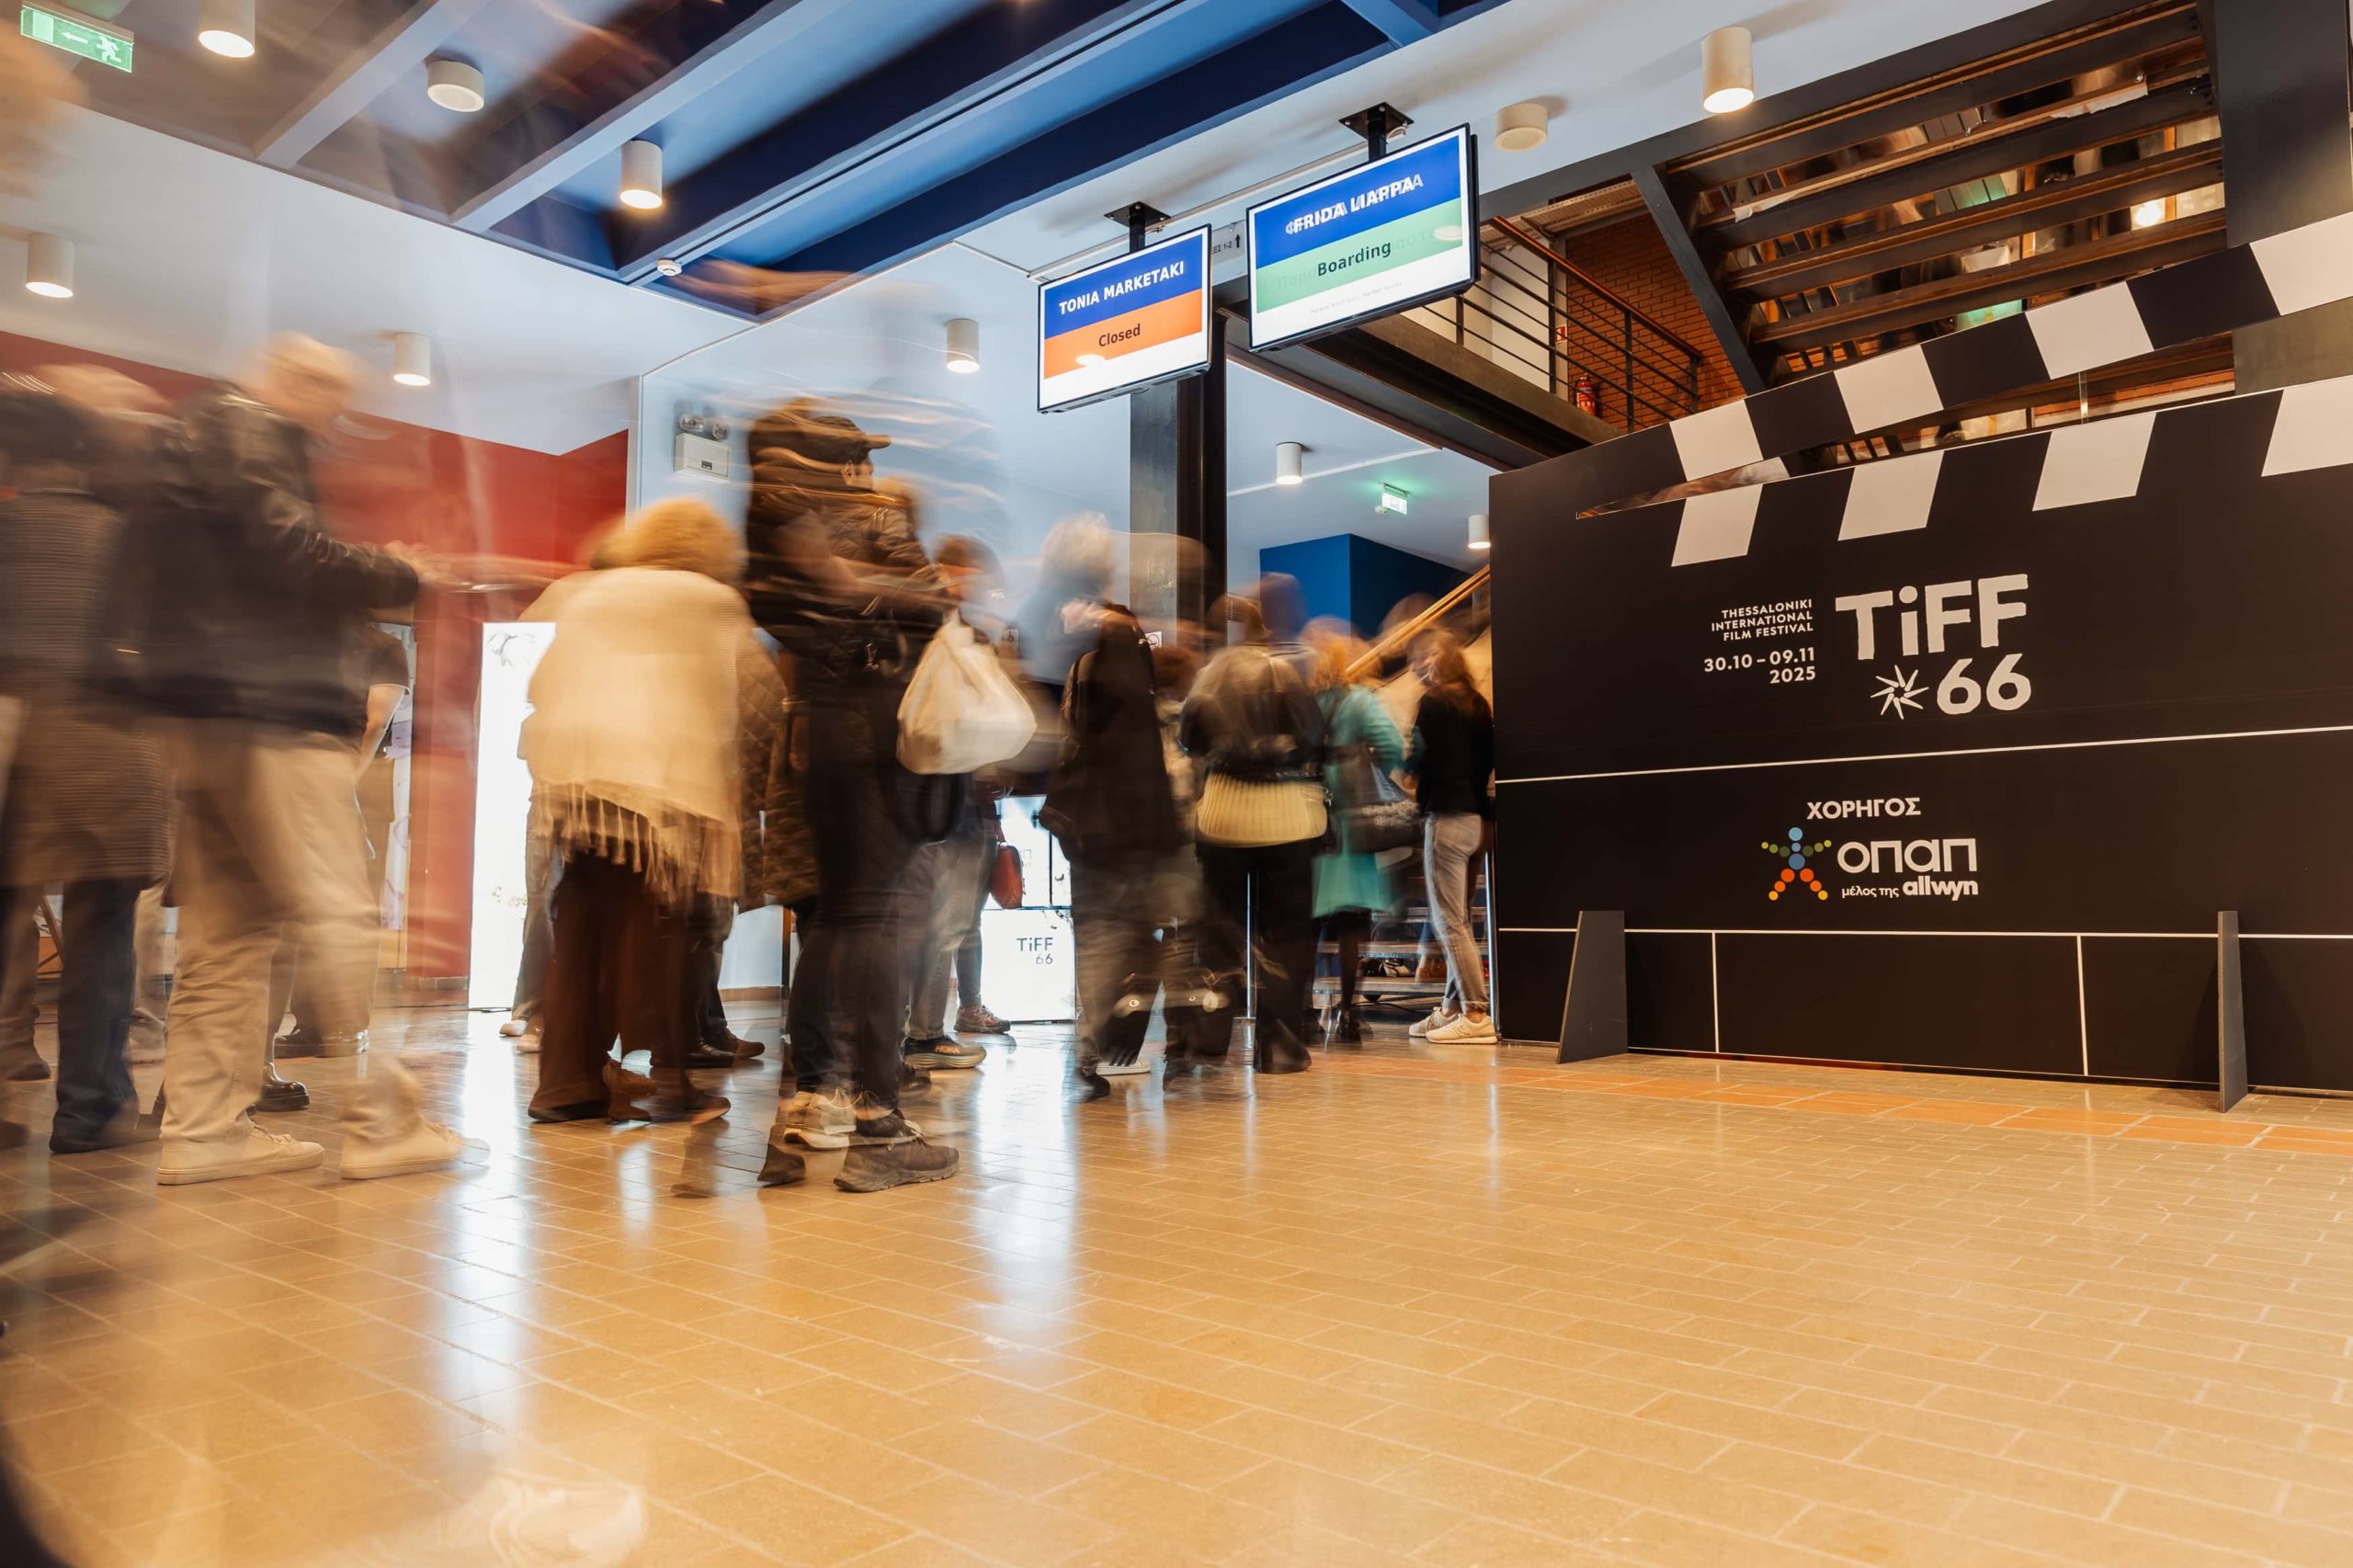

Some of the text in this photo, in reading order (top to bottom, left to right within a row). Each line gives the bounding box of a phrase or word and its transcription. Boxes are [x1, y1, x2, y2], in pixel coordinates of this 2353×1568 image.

[1317, 242, 1392, 277] Boarding
[1059, 260, 1185, 315] TONIA MARKETAKI
[1098, 323, 1141, 347] Closed
[1721, 598, 1813, 619] THESSALONIKI
[1711, 610, 1813, 632] INTERNATIONAL
[1723, 622, 1813, 642] FILM FESTIVAL
[1769, 665, 1816, 685] 2025
[1936, 653, 2032, 715] 66
[1806, 797, 1922, 820] ΧΟΡΗΓΟΣ
[1841, 875, 1979, 902] μέλος της allwyn
[1035, 953, 1053, 965] 66
